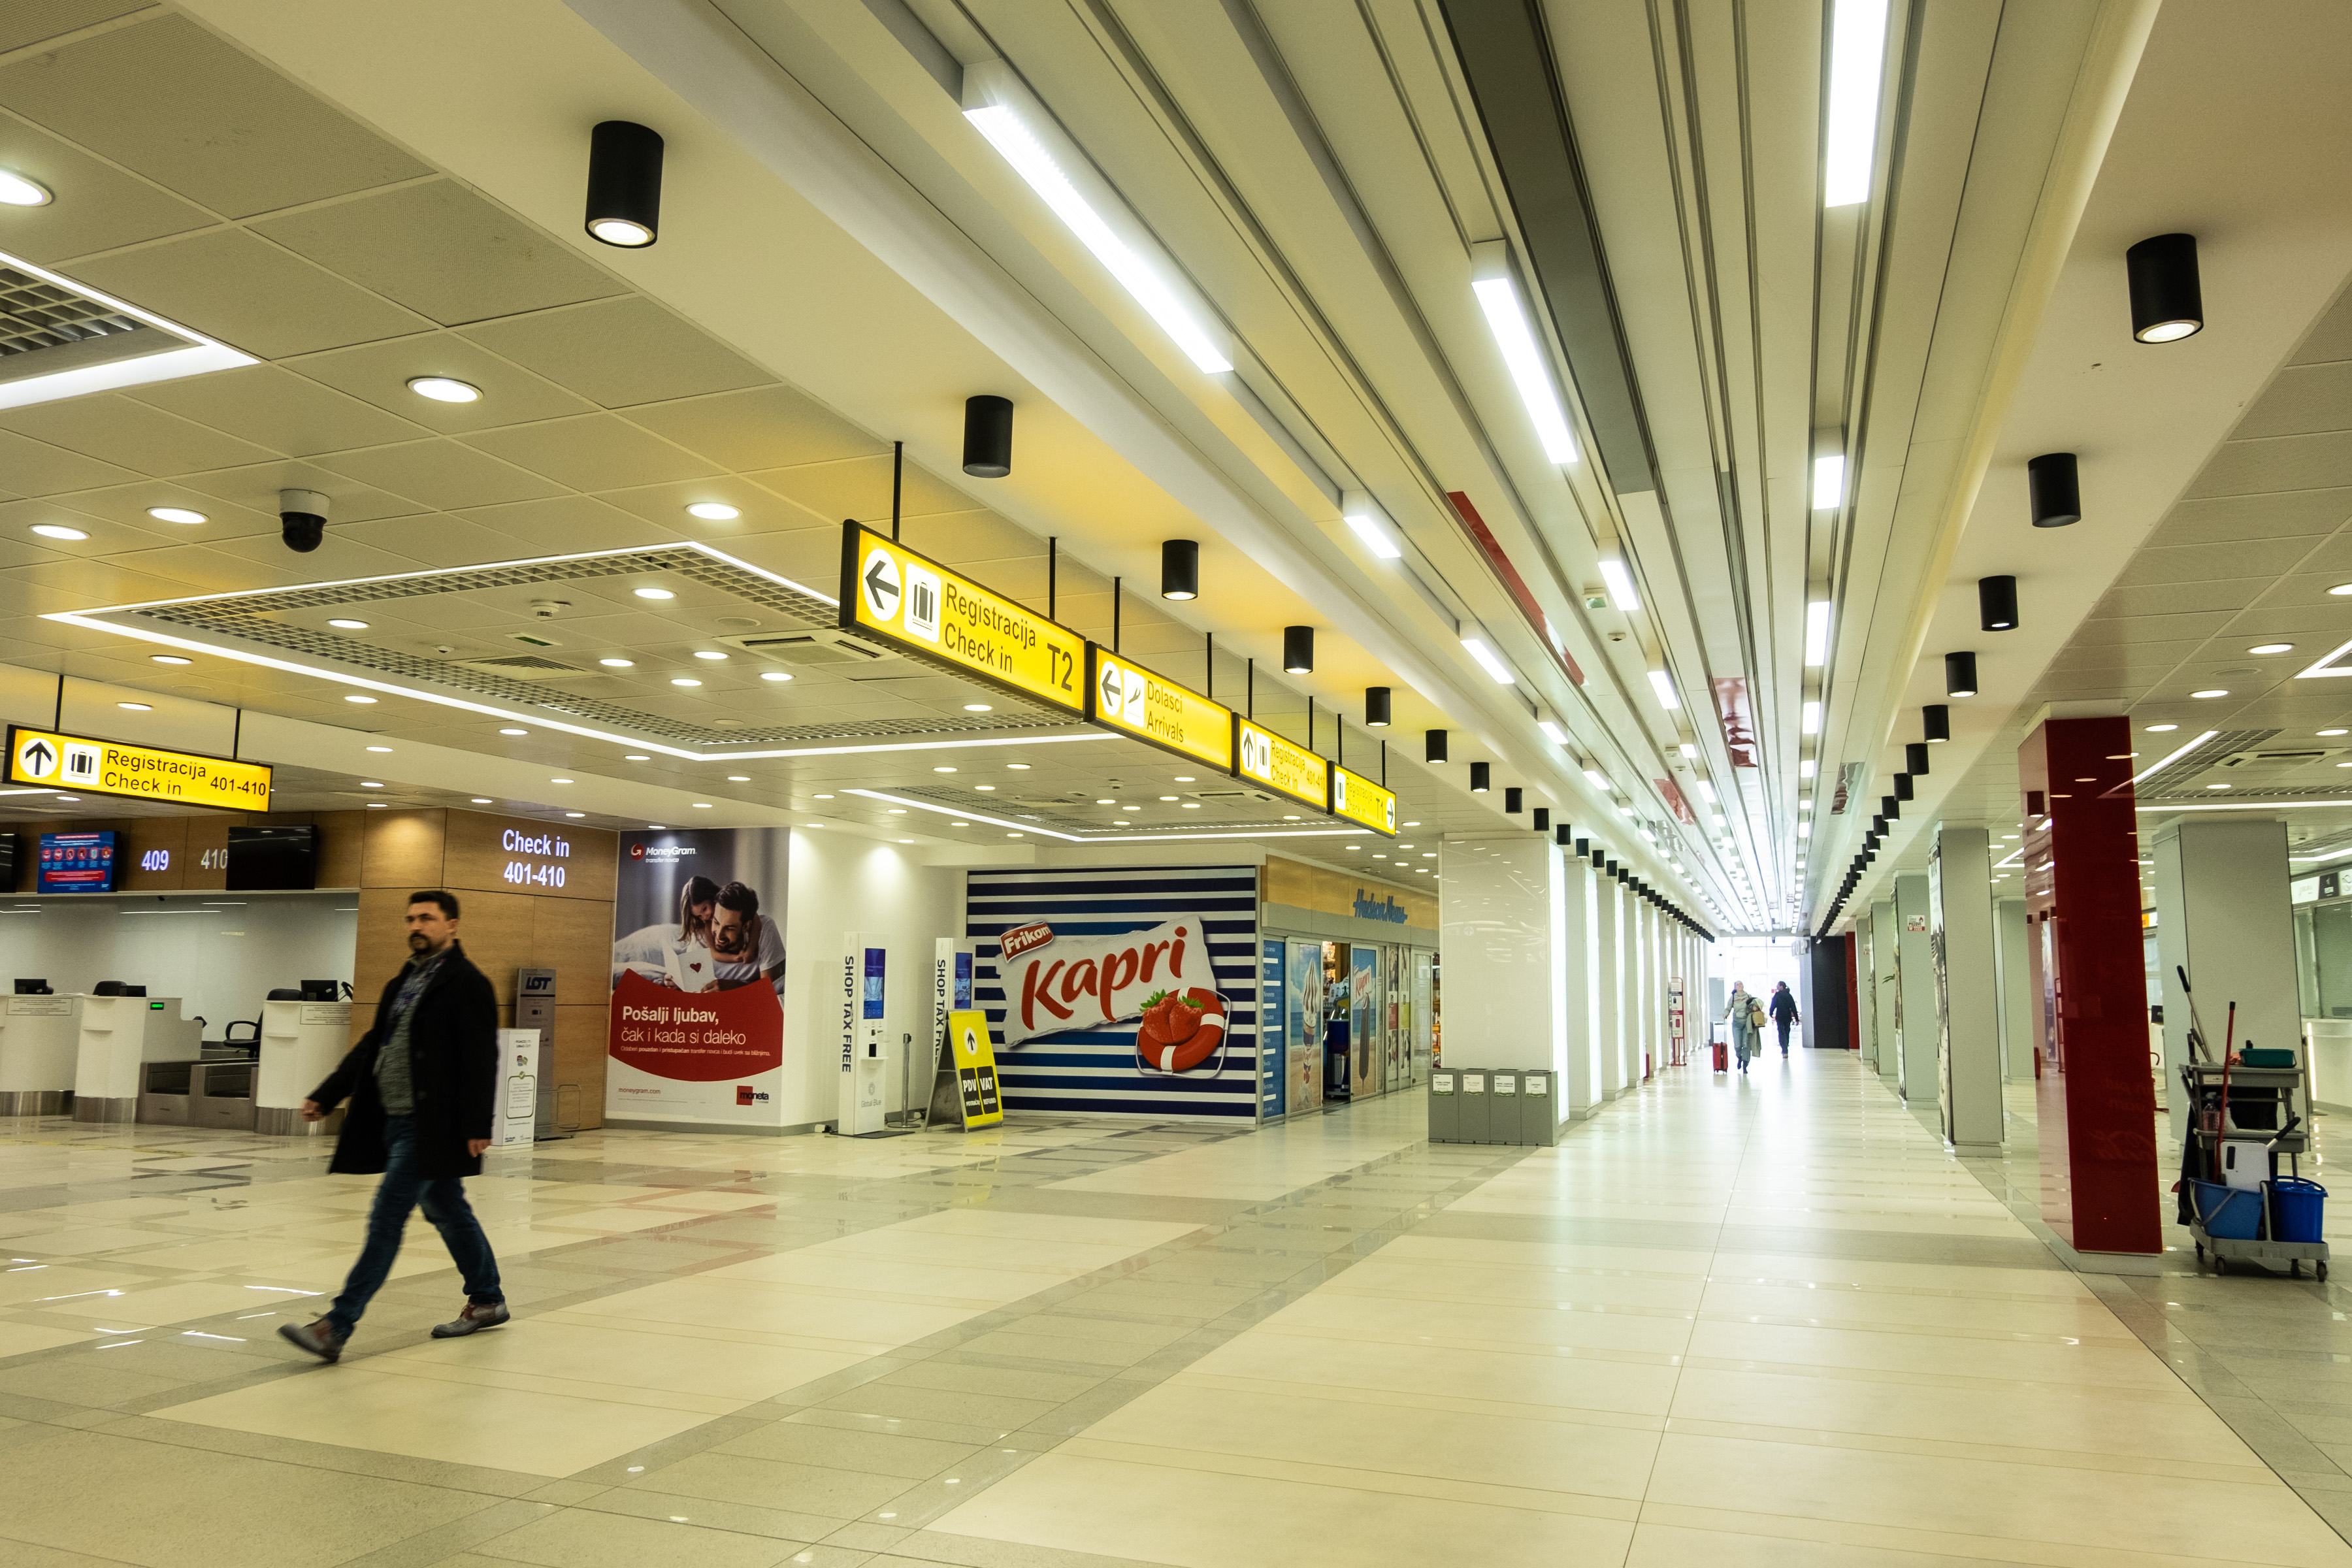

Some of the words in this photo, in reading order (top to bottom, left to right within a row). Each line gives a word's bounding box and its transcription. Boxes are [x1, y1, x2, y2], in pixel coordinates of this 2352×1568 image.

[946, 581, 1036, 650] Registracija
[945, 622, 995, 667] Check
[1000, 645, 1013, 674] in
[1047, 643, 1073, 693] T2
[1147, 679, 1183, 714] Dolasci
[1146, 710, 1184, 743] Arrivals
[106, 750, 206, 780] Registracija
[1271, 740, 1305, 774] Registracija
[105, 772, 161, 793] Check
[167, 780, 182, 796] in
[210, 776, 267, 796] 401-410
[1271, 764, 1291, 787] Check
[1292, 771, 1298, 791] in
[1306, 770, 1326, 791] 401-410
[1346, 777, 1373, 804] Registracija
[1346, 798, 1362, 817] Check
[1376, 798, 1384, 822] T1
[502, 828, 552, 855] Check
[555, 836, 570, 857] in
[140, 850, 169, 871] 409
[201, 848, 228, 870] 410
[503, 861, 566, 888] 401-410
[1004, 924, 1051, 955] Frikom
[525, 977, 553, 990] LOT
[844, 956, 854, 998] SHOP
[937, 959, 946, 997] SHOP
[1021, 926, 1188, 1031] Kapri
[623, 1006, 669, 1025] Pošalji
[674, 1007, 719, 1026] ljubav,
[843, 1000, 853, 1030] TAX
[936, 1000, 945, 1026] TAX
[621, 1026, 644, 1042] čak
[647, 1028, 651, 1042] i
[655, 1028, 686, 1043] kada
[689, 1030, 700, 1044] si
[703, 1030, 746, 1045] daleko
[842, 1034, 852, 1072] FREE
[740, 1092, 769, 1100] moneta
[962, 1079, 977, 1092] PDV
[979, 1077, 993, 1091] VAT
